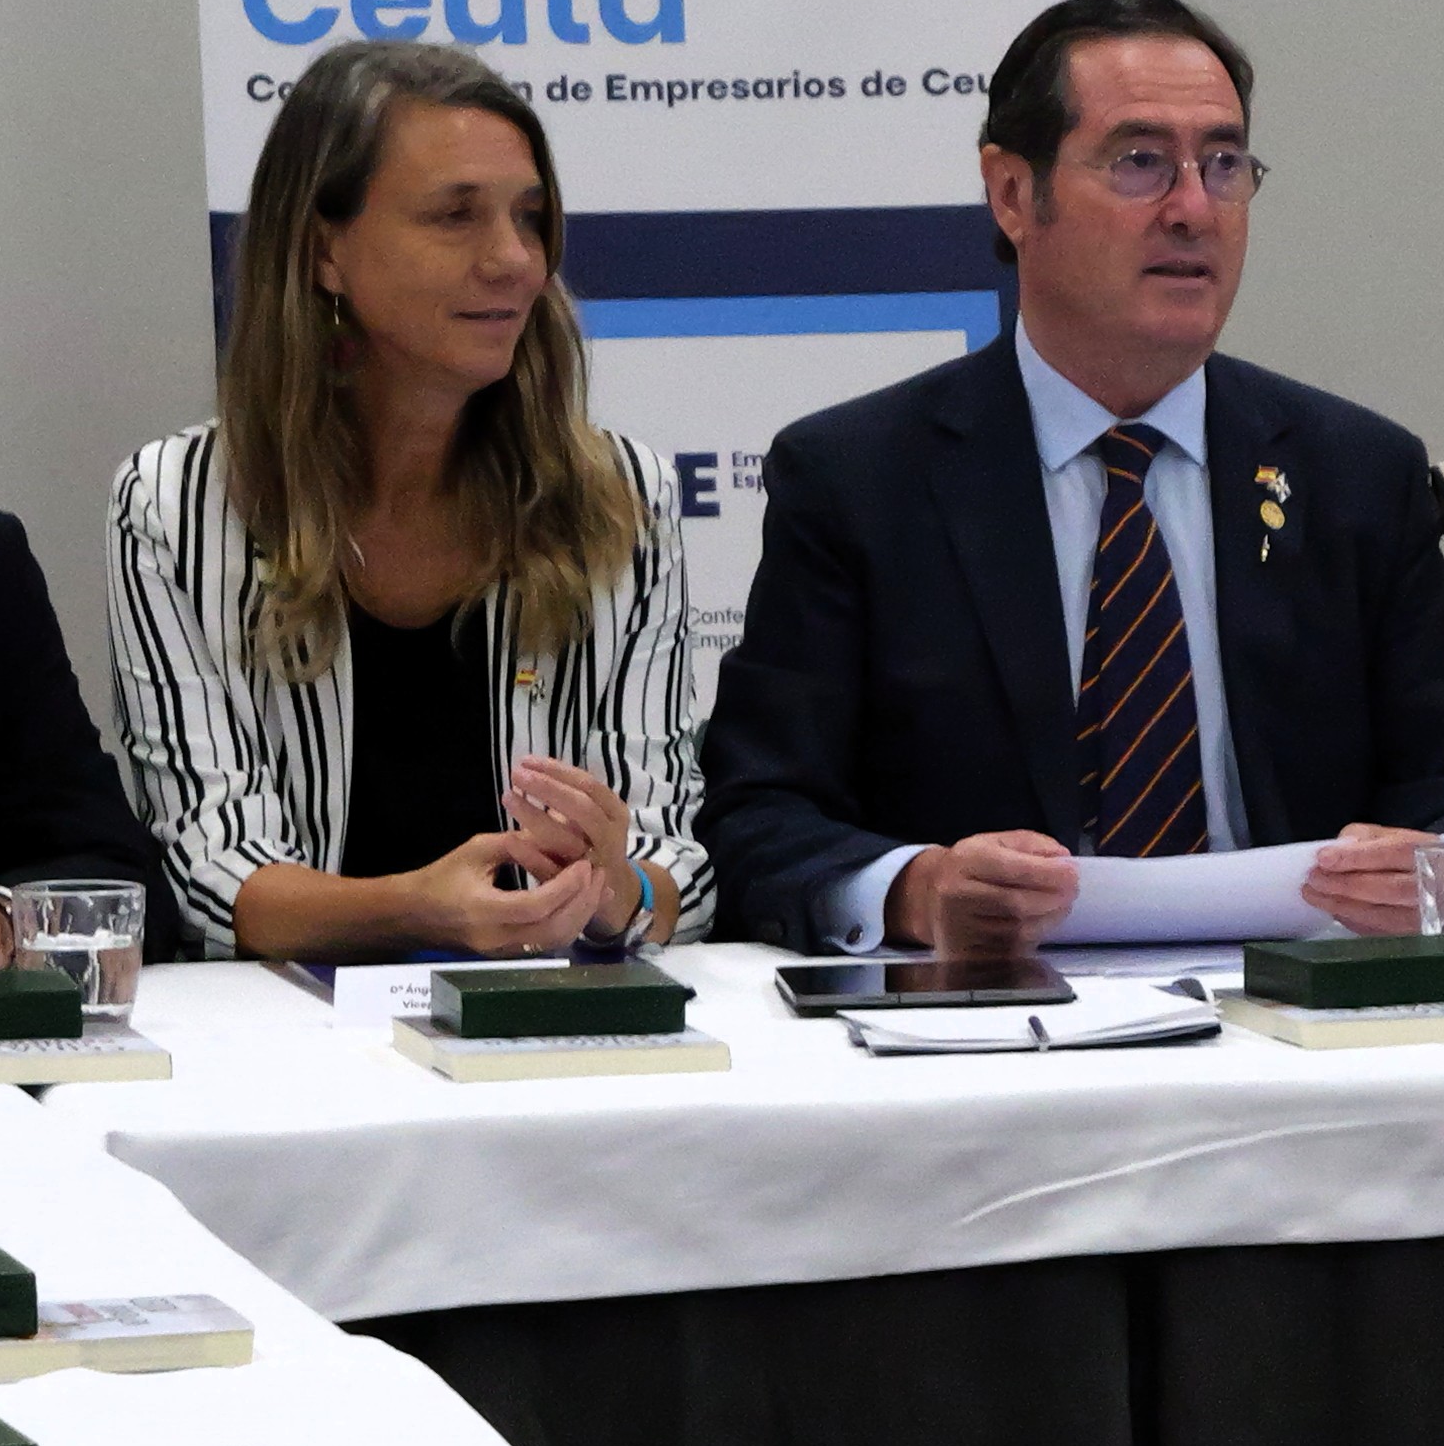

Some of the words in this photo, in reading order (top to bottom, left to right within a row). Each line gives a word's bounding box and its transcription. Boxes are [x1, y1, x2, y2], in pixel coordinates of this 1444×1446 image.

[546, 74, 593, 103] de
[605, 70, 847, 105] Empresarios
[860, 68, 907, 97] de
[921, 67, 990, 96] Ceu
